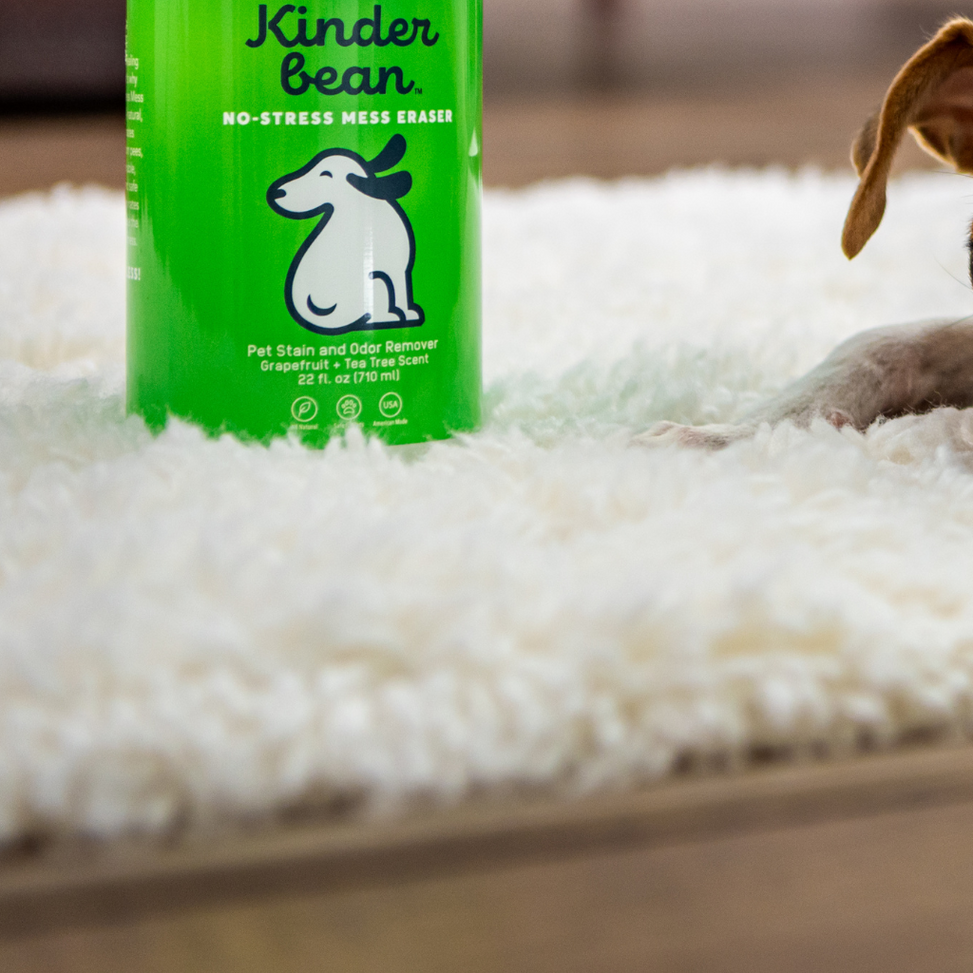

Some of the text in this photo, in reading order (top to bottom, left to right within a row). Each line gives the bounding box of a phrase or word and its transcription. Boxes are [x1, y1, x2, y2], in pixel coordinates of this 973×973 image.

[245, 4, 439, 48] Kinder
[280, 52, 415, 96] bean
[223, 109, 453, 125] NO-STRESS MESS ERASER
[247, 339, 439, 357] Pet Stain and Odor Remover
[260, 359, 330, 373] Grapefruit
[345, 357, 366, 369] Tea
[370, 356, 395, 368] Tree
[398, 353, 429, 366] Scent
[298, 369, 400, 385] 22 fl. oz (710 ml)
[382, 400, 398, 409] USA
